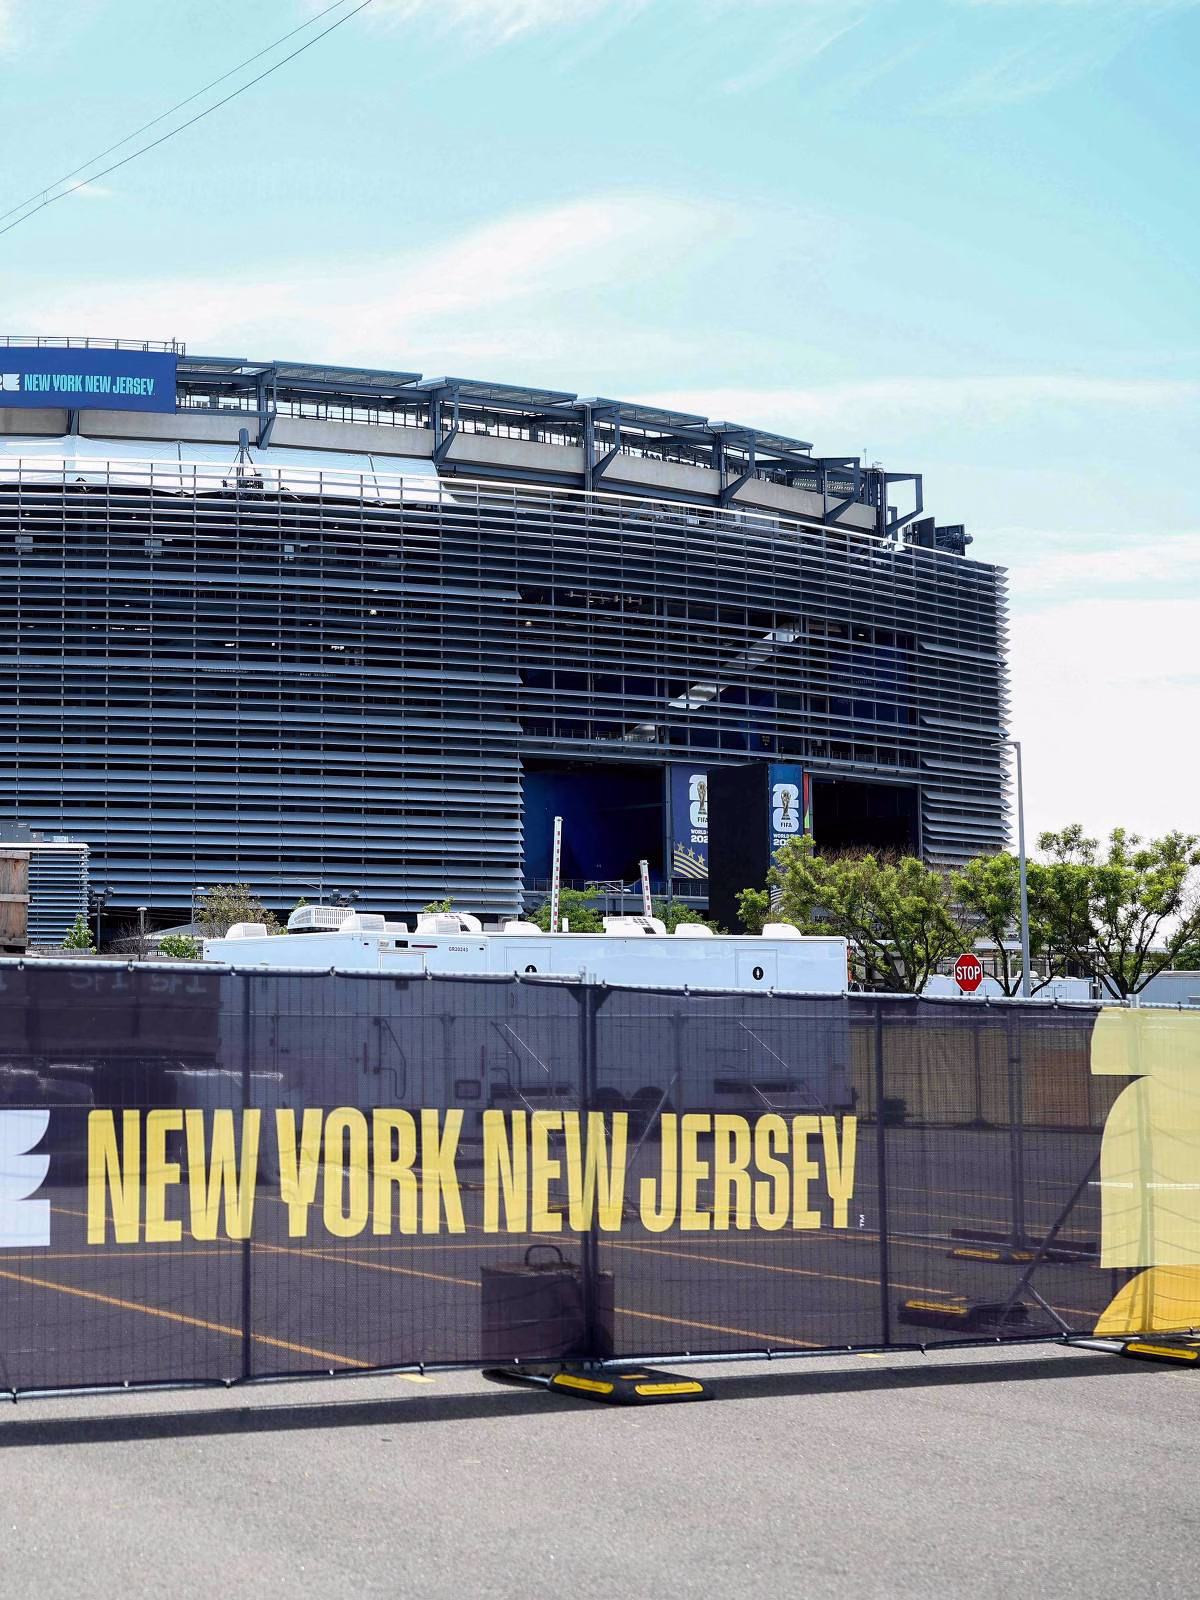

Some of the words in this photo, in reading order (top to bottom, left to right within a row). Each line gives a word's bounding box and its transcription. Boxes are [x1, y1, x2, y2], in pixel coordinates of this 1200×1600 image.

[24, 374, 51, 392] NEW
[52, 374, 83, 392] YORK
[85, 375, 111, 393] NEW
[112, 376, 155, 396] JERSEY
[690, 834, 709, 844] 202
[956, 965, 981, 981] STOP
[86, 1107, 262, 1245] NEW
[275, 1107, 468, 1238] YORK
[483, 1109, 629, 1235] NEW
[639, 1112, 859, 1233] JERSEY
